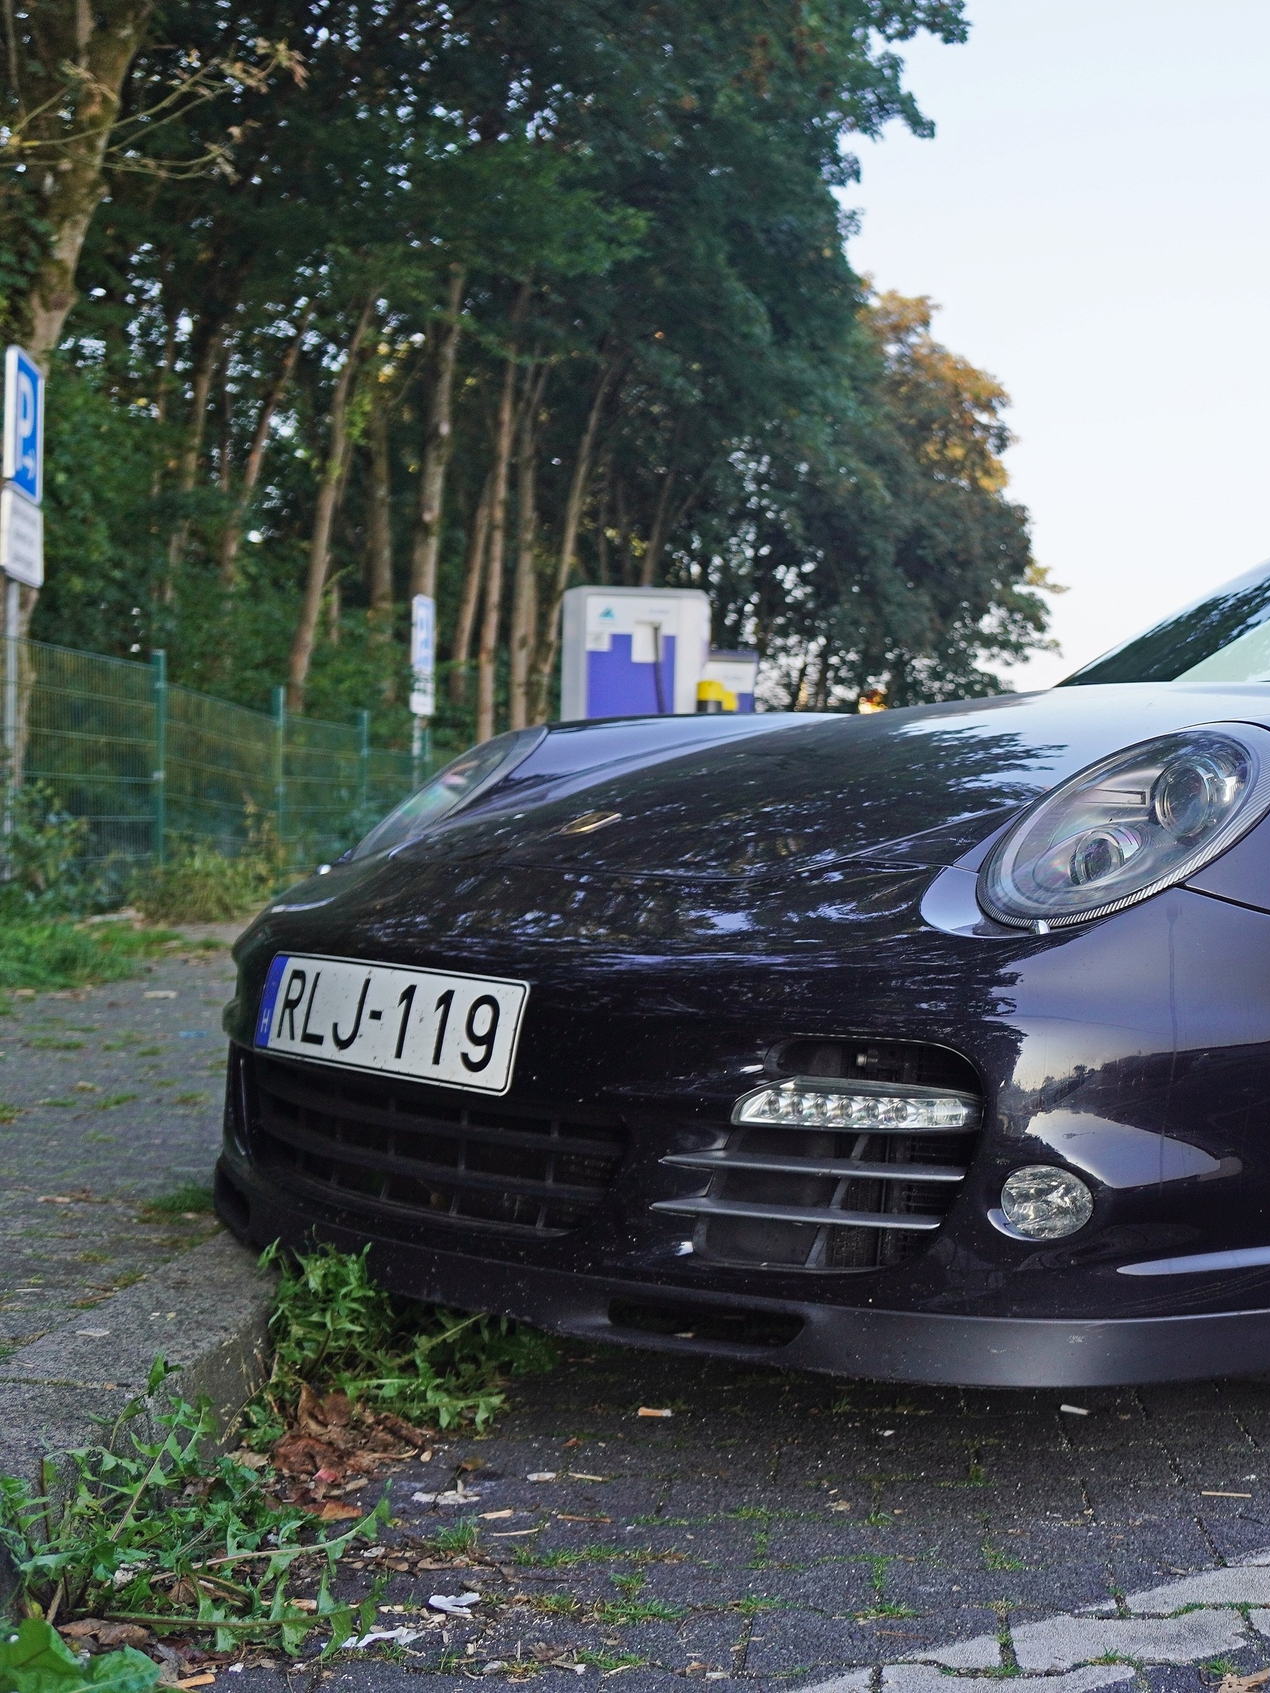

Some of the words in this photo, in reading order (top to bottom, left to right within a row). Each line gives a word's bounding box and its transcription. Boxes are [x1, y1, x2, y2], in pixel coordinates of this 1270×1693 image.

[16, 371, 35, 472] P
[260, 1008, 270, 1033] H
[276, 969, 501, 1073] RLJ-119
